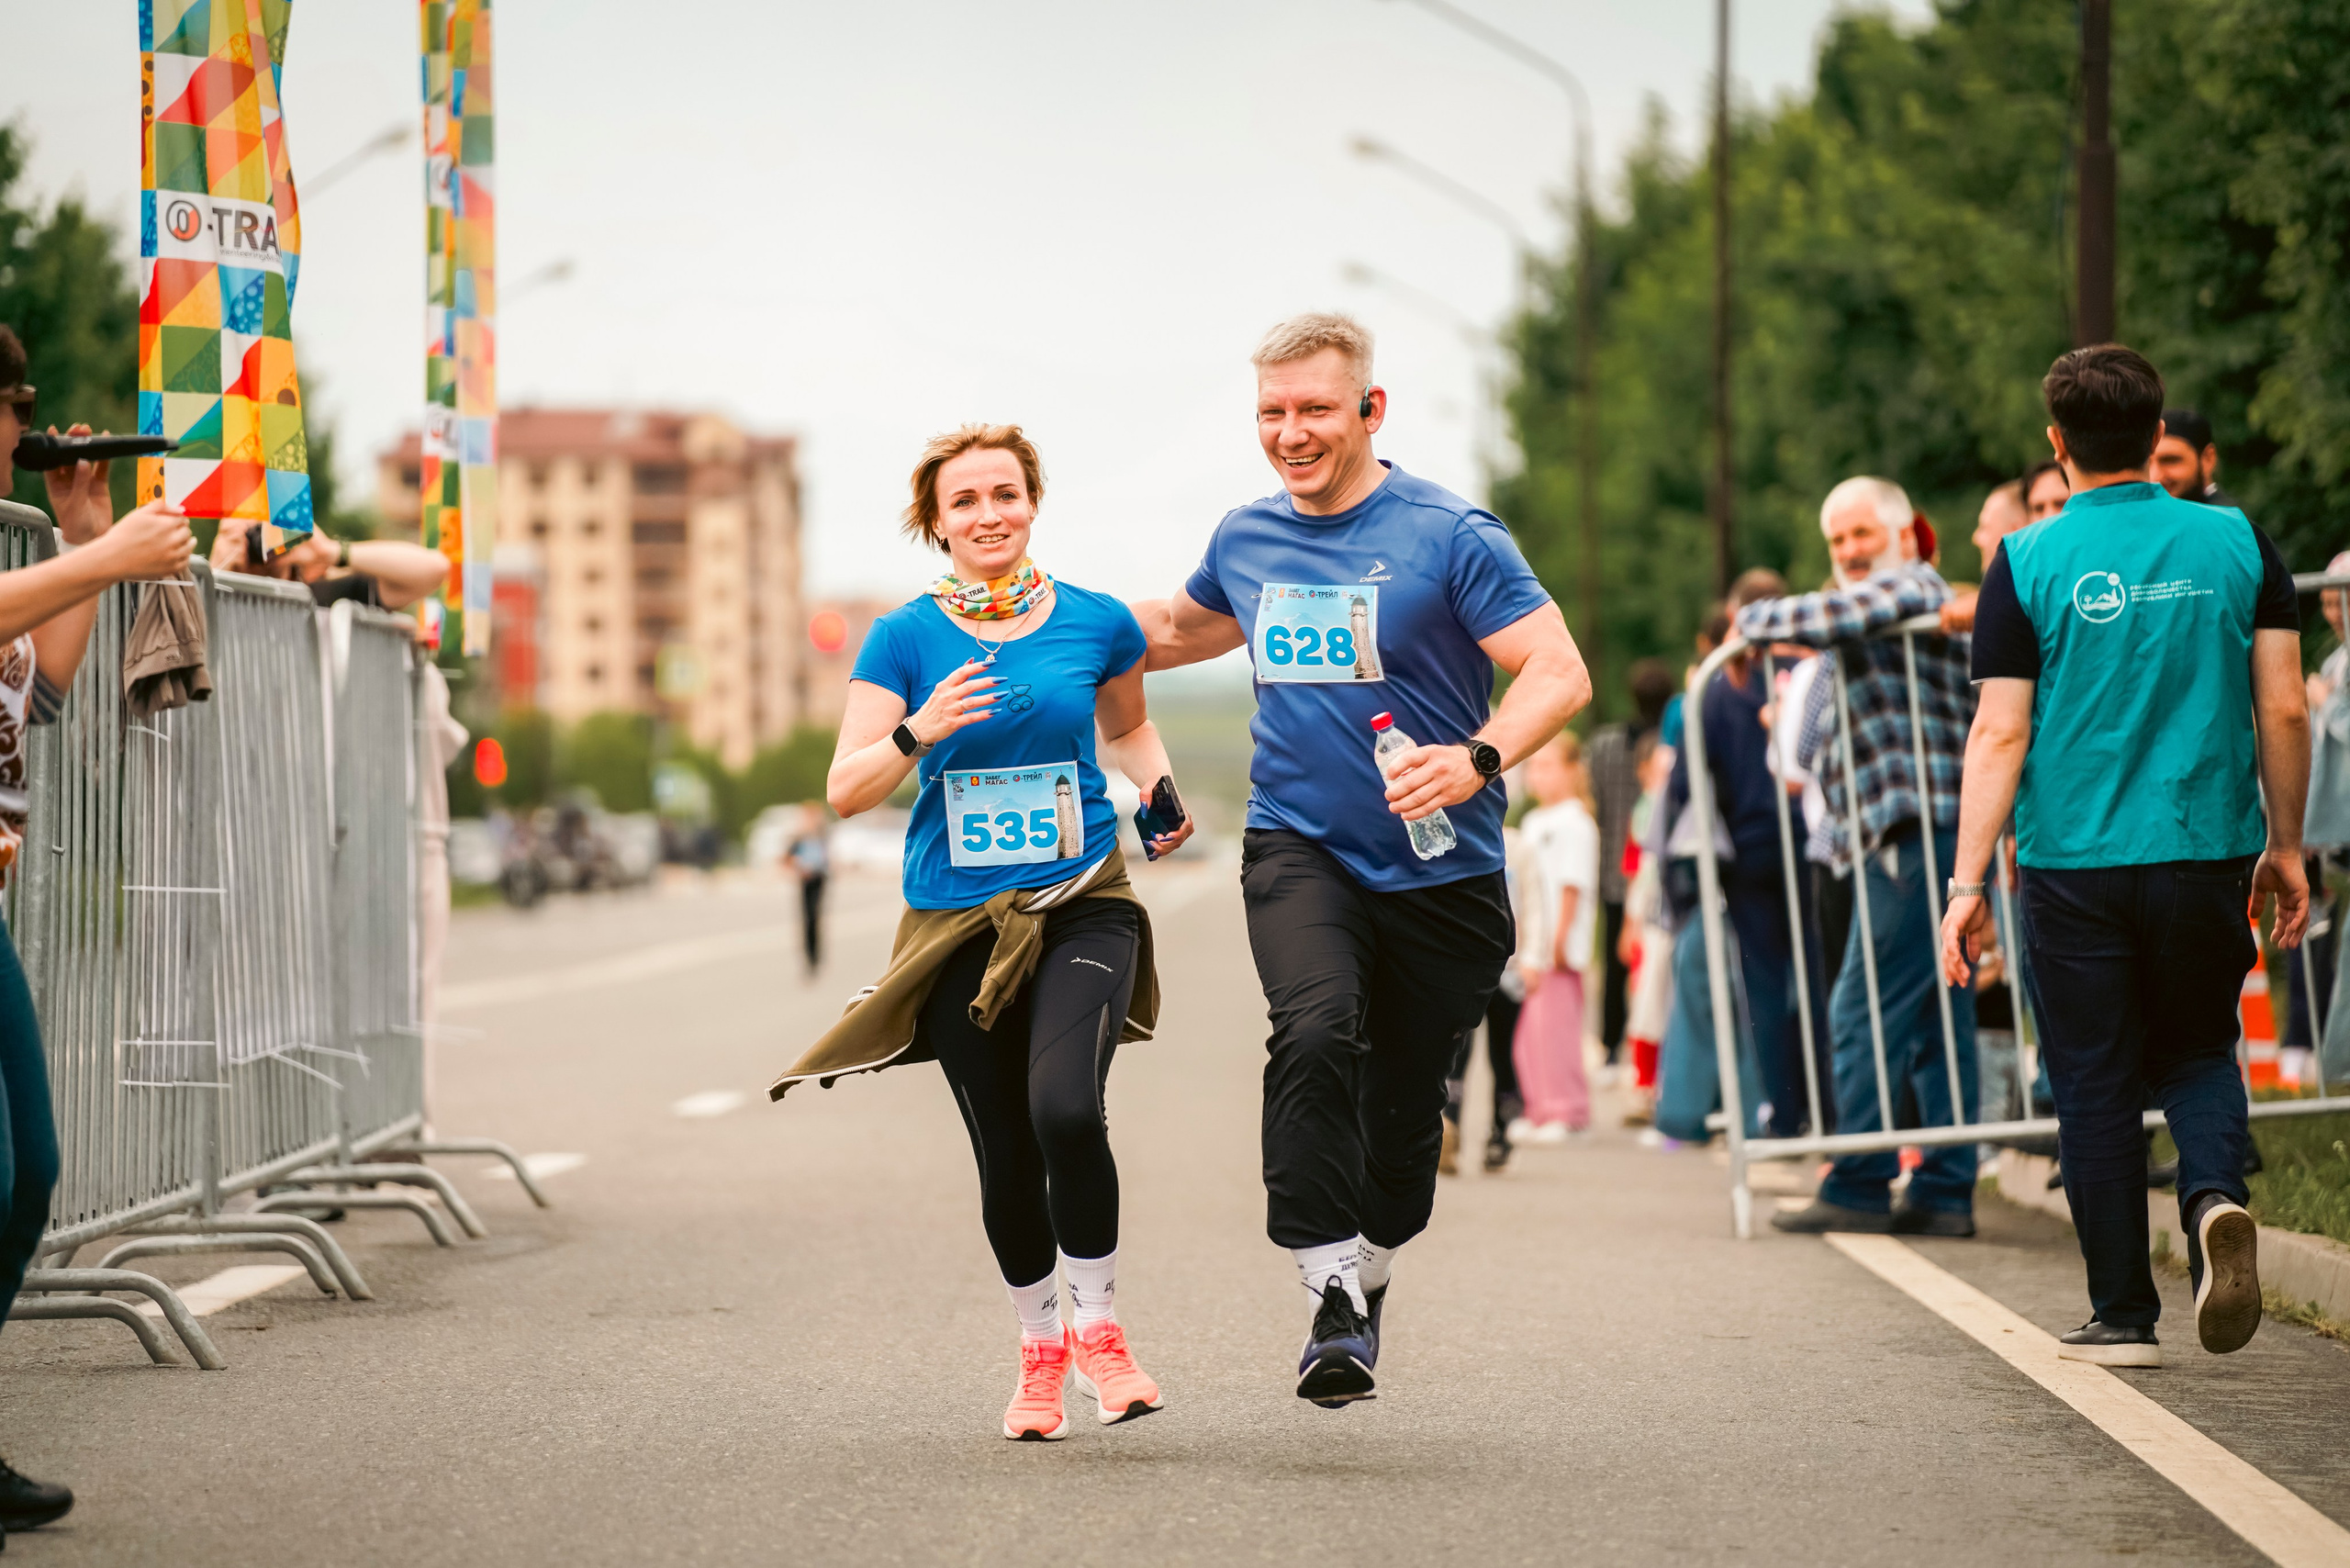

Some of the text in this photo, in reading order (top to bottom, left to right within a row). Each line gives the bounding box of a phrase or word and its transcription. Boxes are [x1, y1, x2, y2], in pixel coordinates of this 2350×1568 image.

[166, 199, 282, 257] O-TRA
[1359, 575, 1393, 583] DEMIX
[1265, 625, 1357, 666] 628
[961, 808, 1059, 853] 535
[1080, 958, 1113, 972] DEMIX
